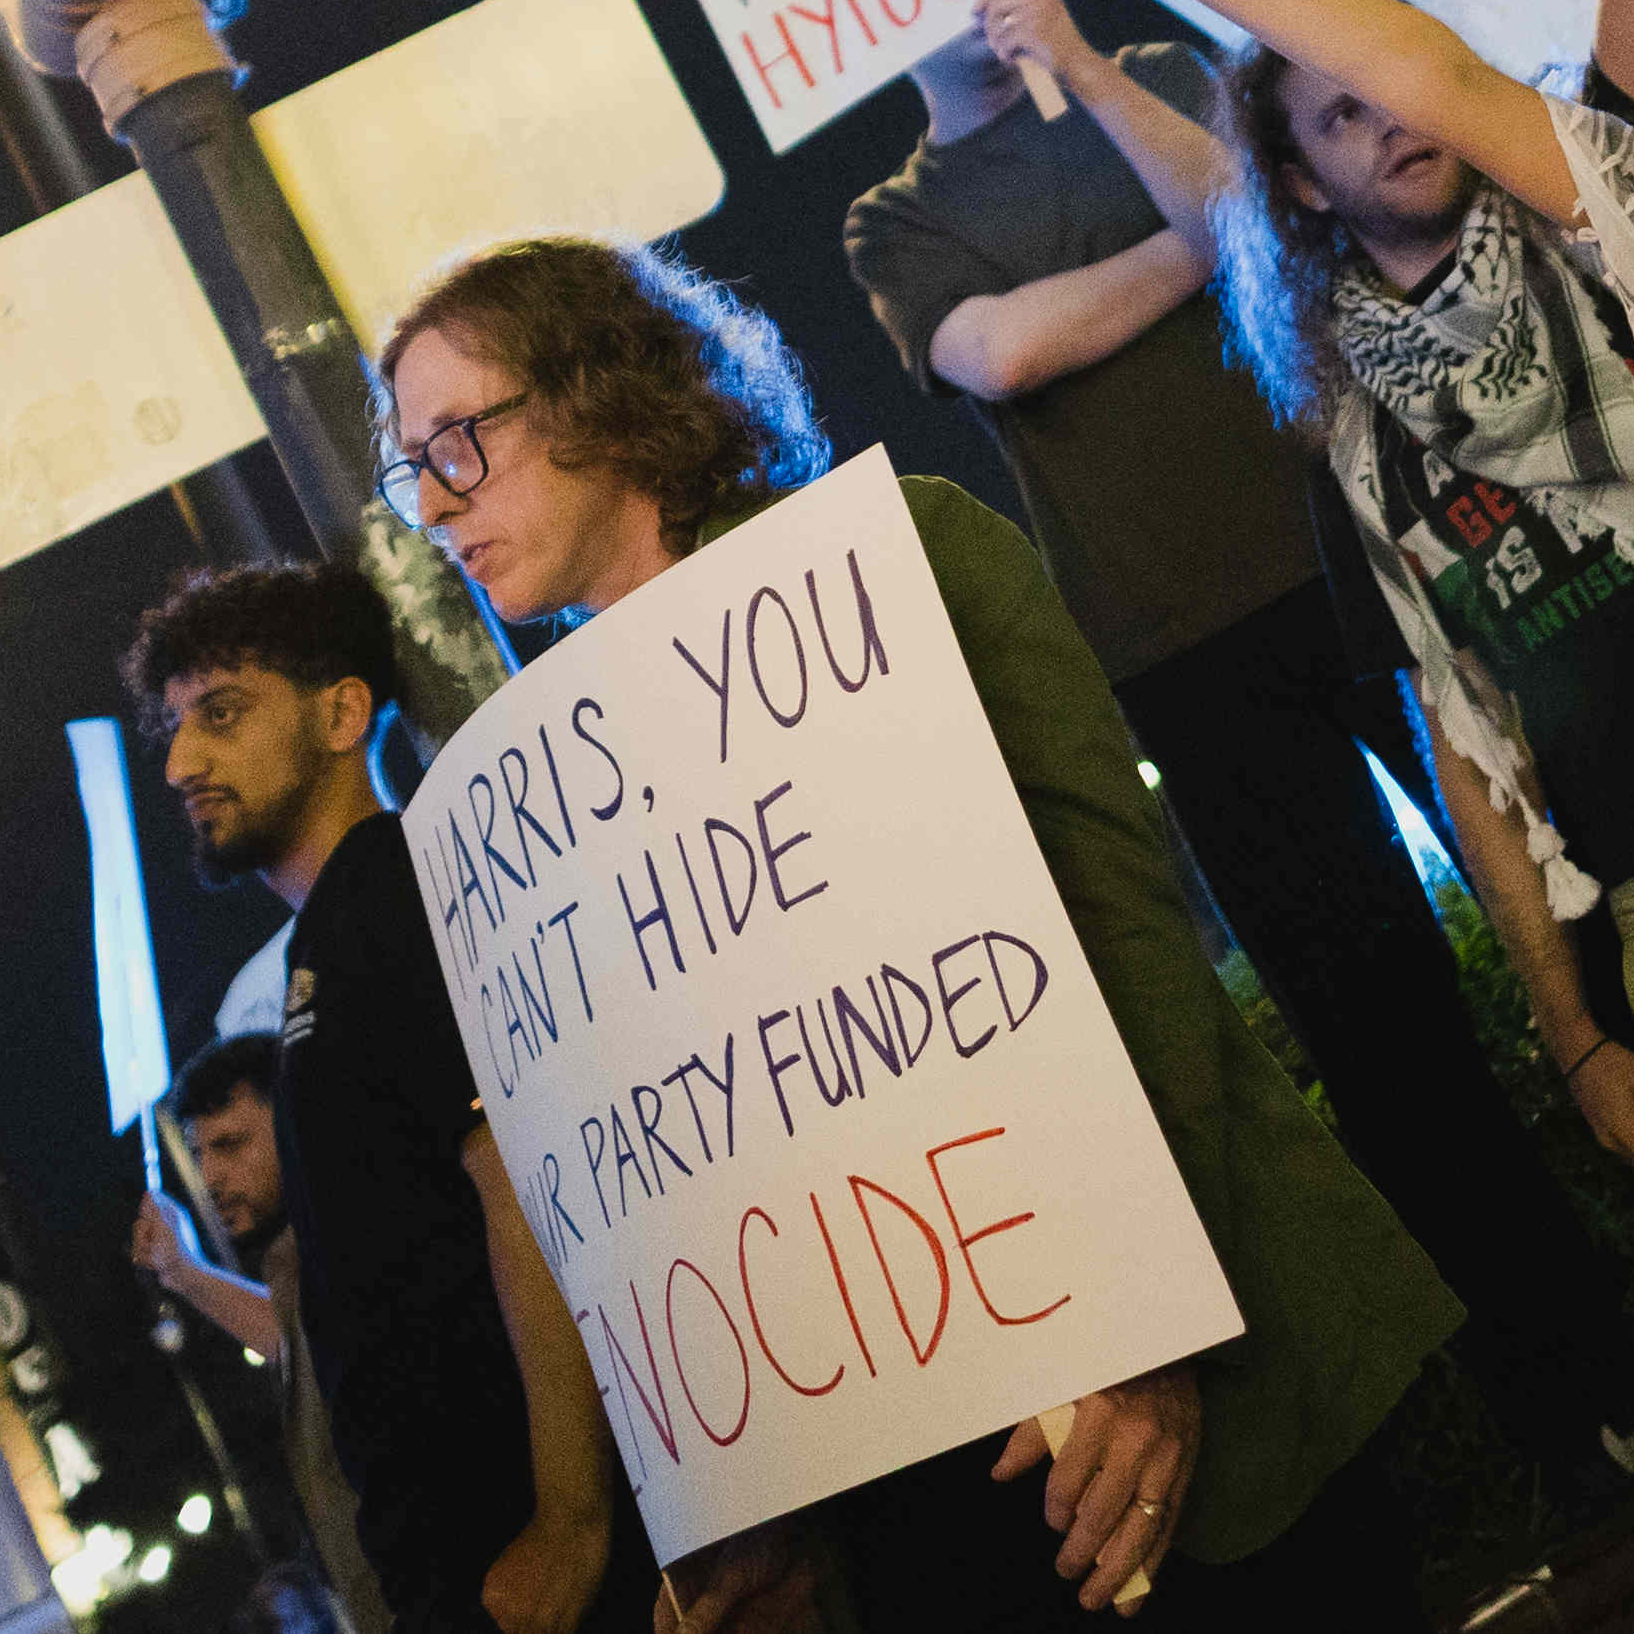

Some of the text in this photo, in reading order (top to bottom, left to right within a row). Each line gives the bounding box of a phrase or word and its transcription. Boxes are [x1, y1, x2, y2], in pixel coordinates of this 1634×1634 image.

[422, 547, 890, 1002] HARRIS, YOU
[478, 779, 830, 1101] CAN'T HIDE
[579, 1032, 737, 1230] PARTY
[757, 929, 1050, 1138] FUNDED
